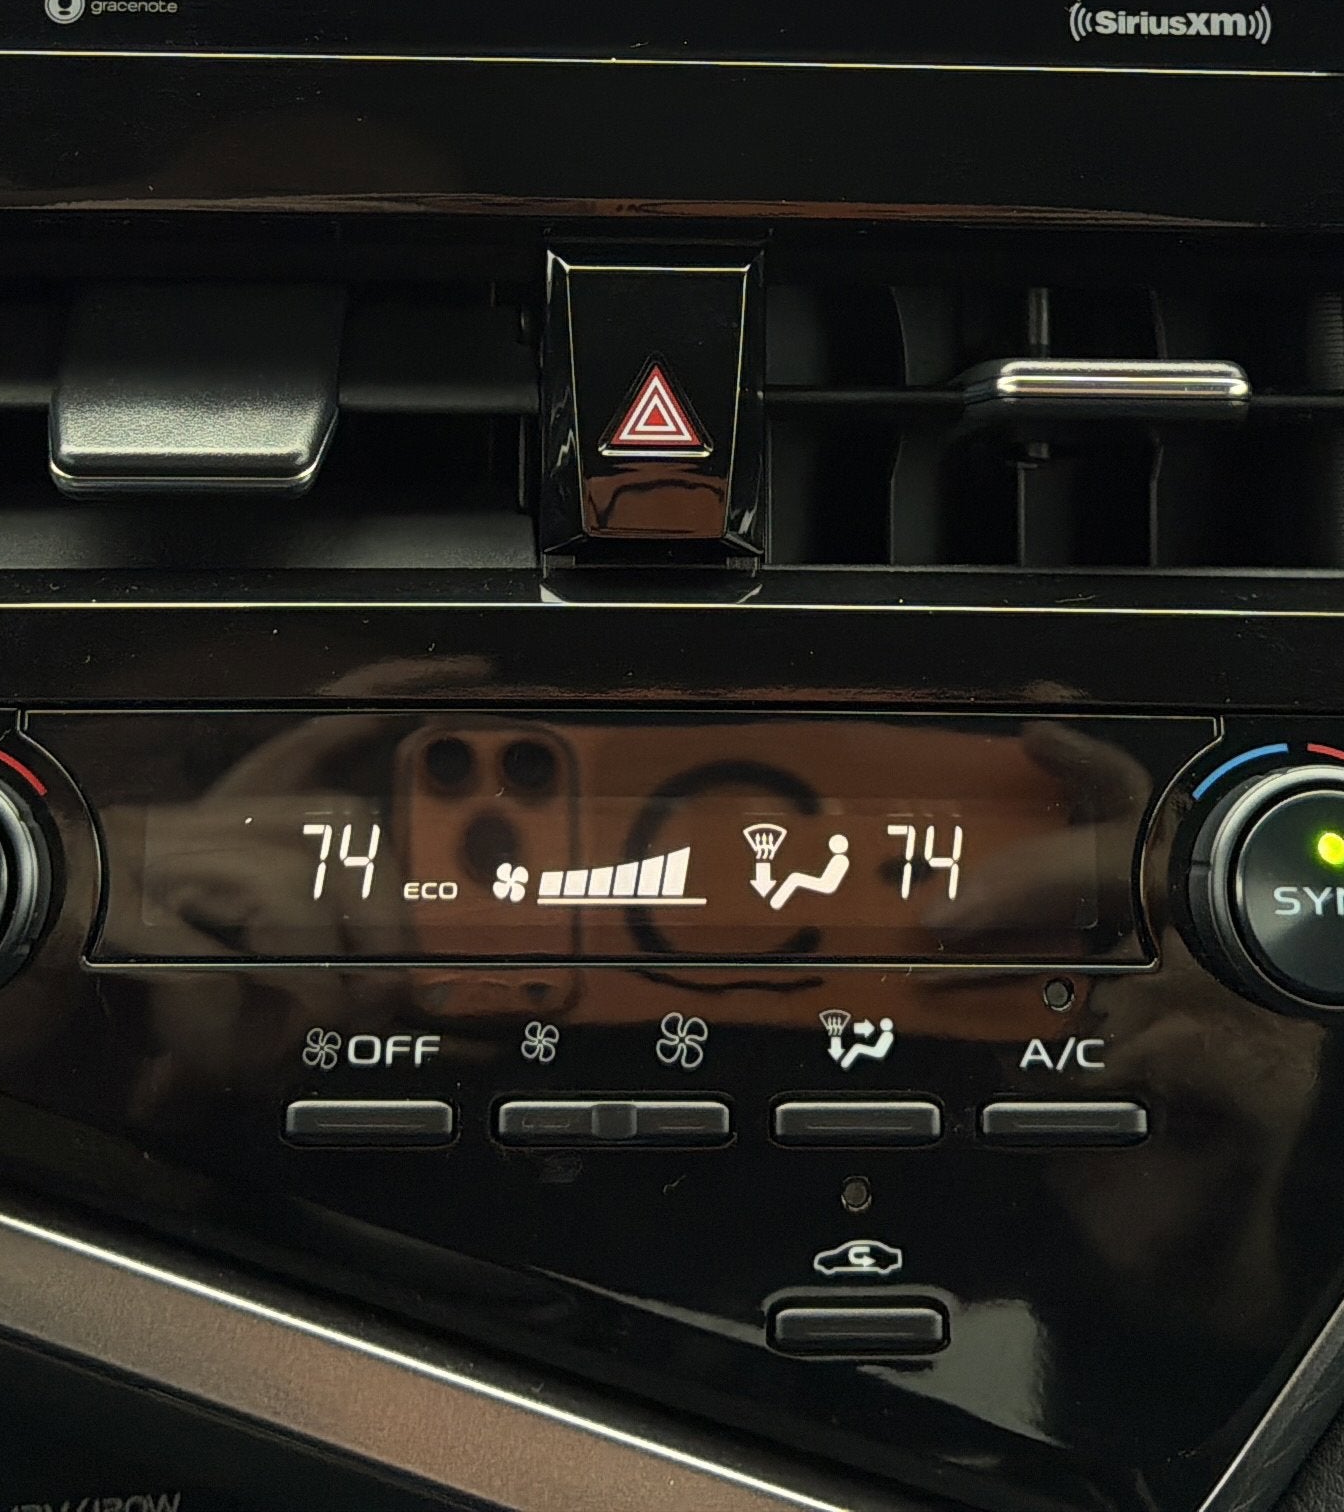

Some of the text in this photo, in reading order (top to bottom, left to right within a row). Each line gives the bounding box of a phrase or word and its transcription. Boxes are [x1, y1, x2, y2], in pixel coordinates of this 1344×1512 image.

[302, 823, 459, 901] 74 ECO
[886, 823, 964, 900] 74
[347, 1034, 441, 1066] OFF
[1019, 1037, 1106, 1071] A/C
